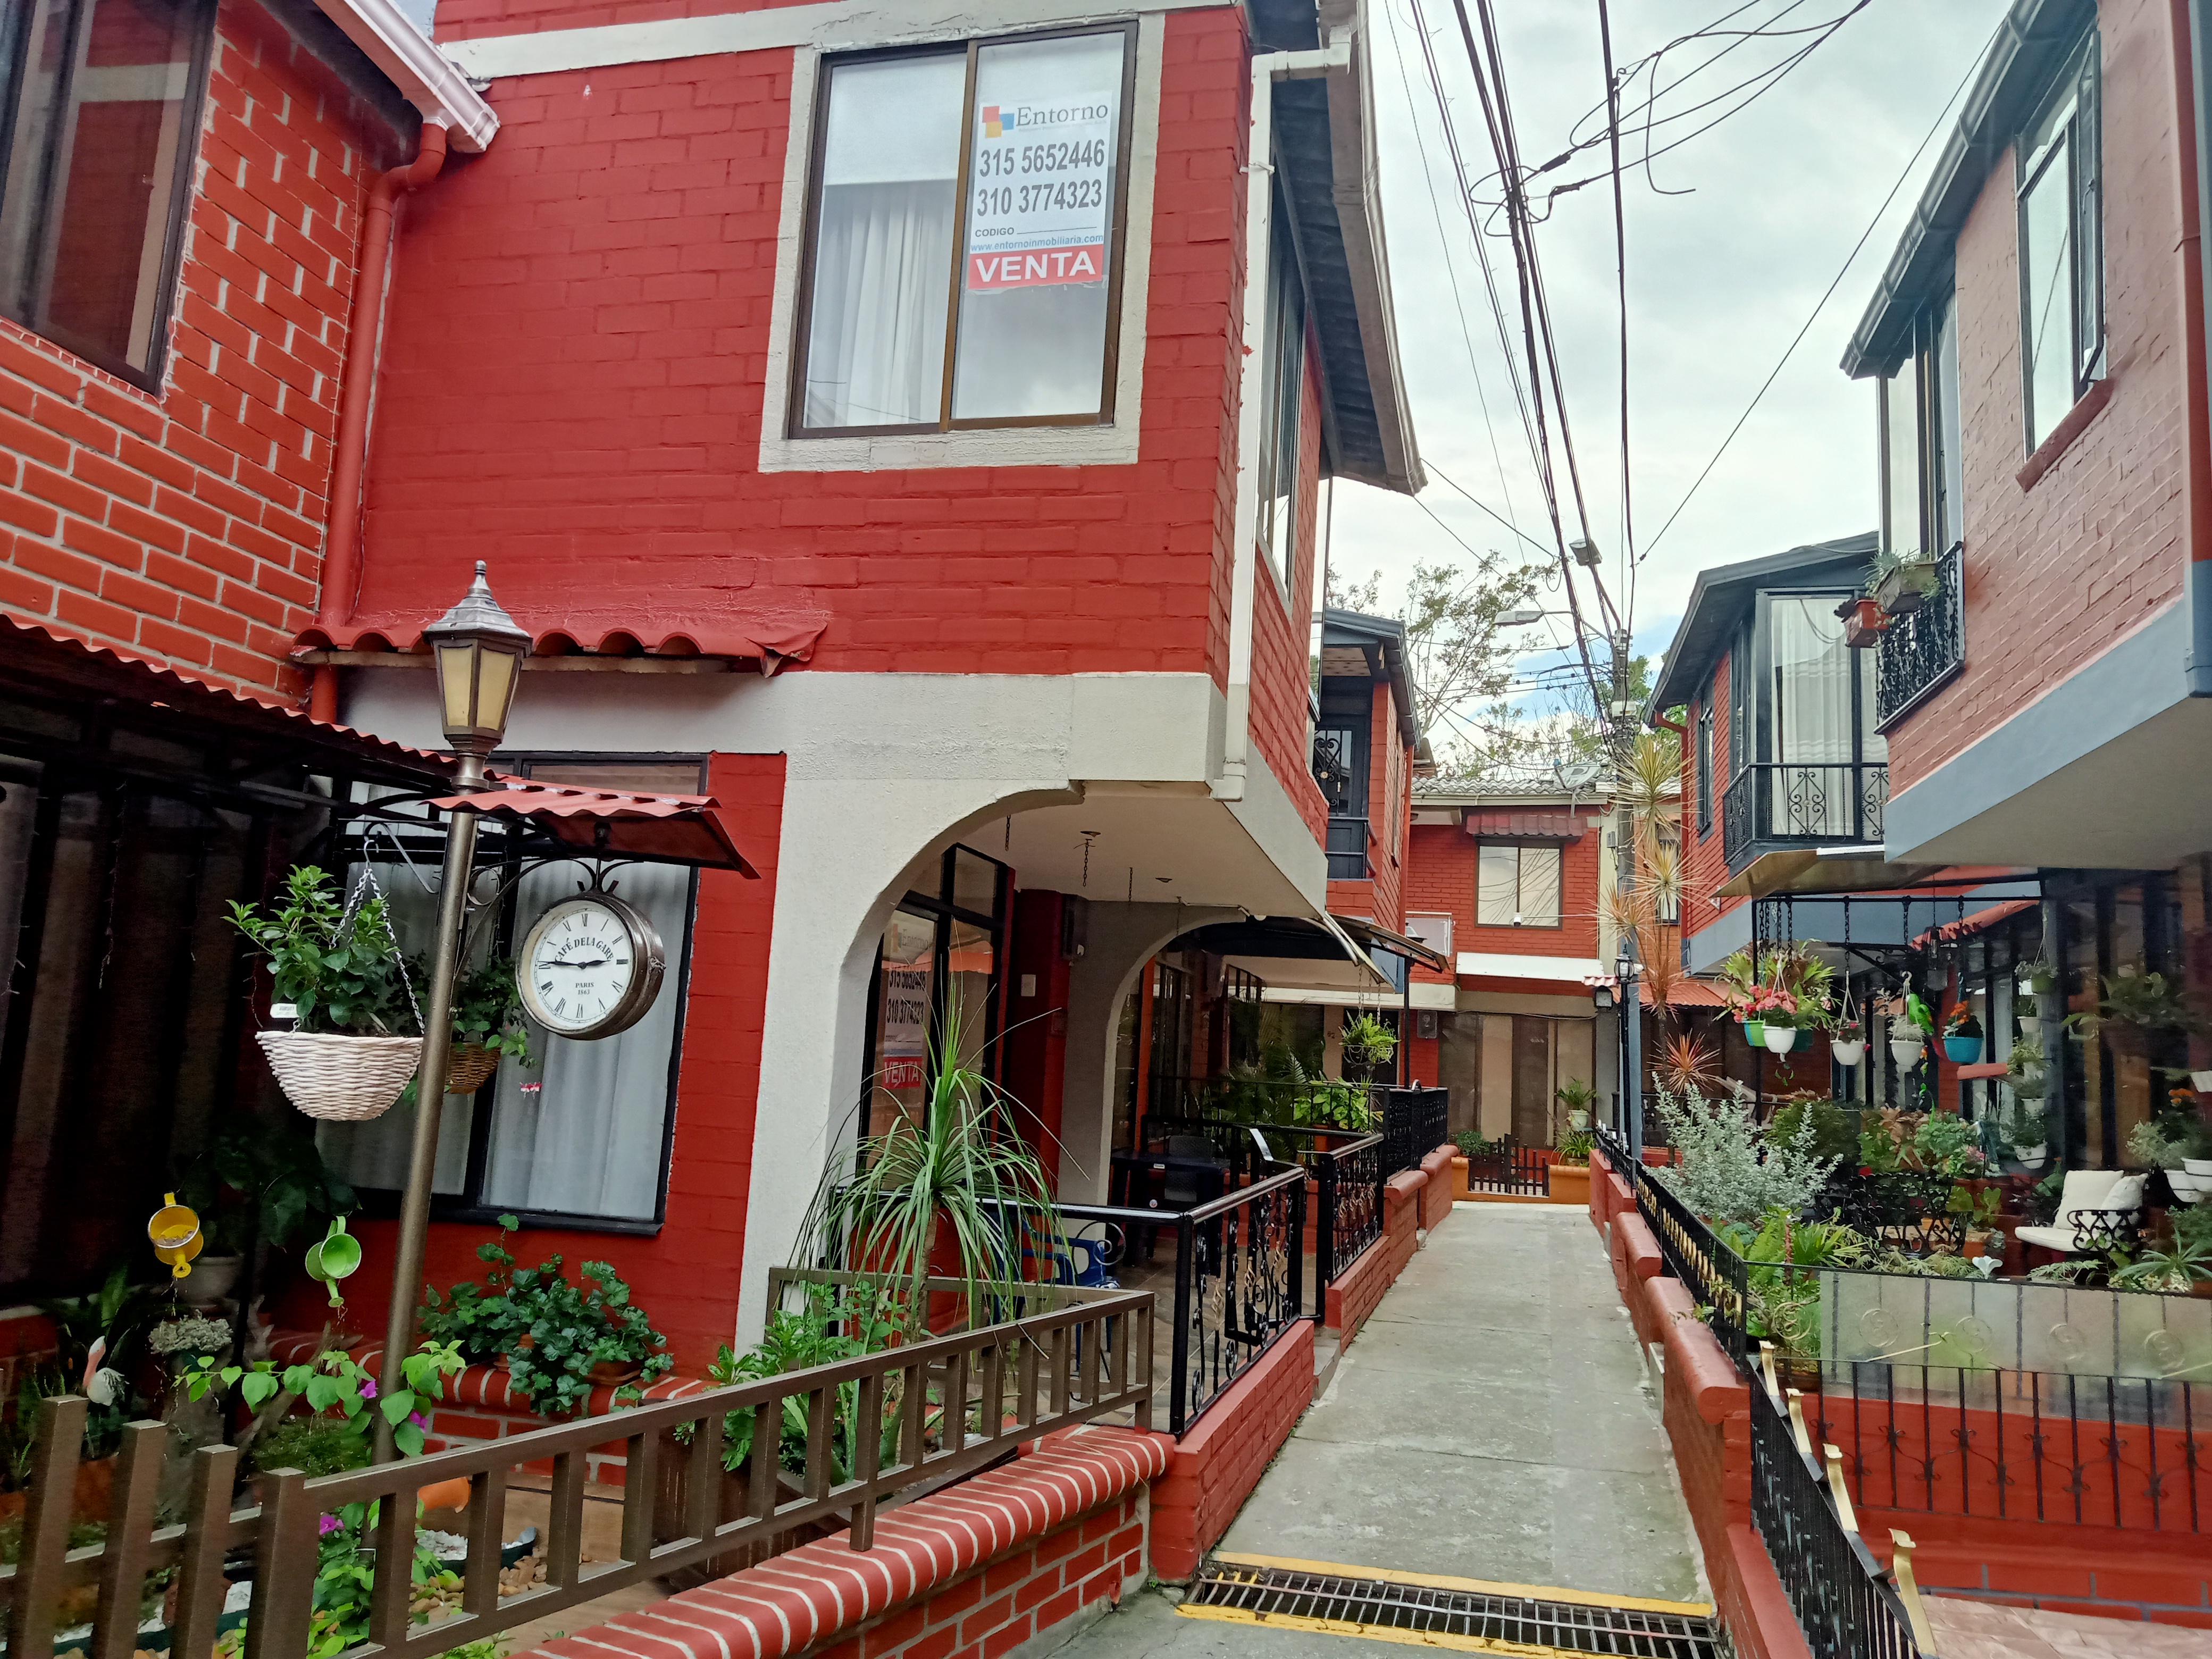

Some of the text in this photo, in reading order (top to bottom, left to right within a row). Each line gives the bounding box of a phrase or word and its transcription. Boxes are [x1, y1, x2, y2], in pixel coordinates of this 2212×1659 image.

[1016, 105, 1108, 127] Entorno
[979, 139, 1105, 177] 315 5652446
[977, 179, 1102, 216] 310 3774323
[970, 234, 1103, 251] www.entornoinmobiliaria.com
[975, 227, 1015, 237] CODIGO
[975, 250, 1096, 282] VENTA
[884, 1061, 919, 1083] VENTA
